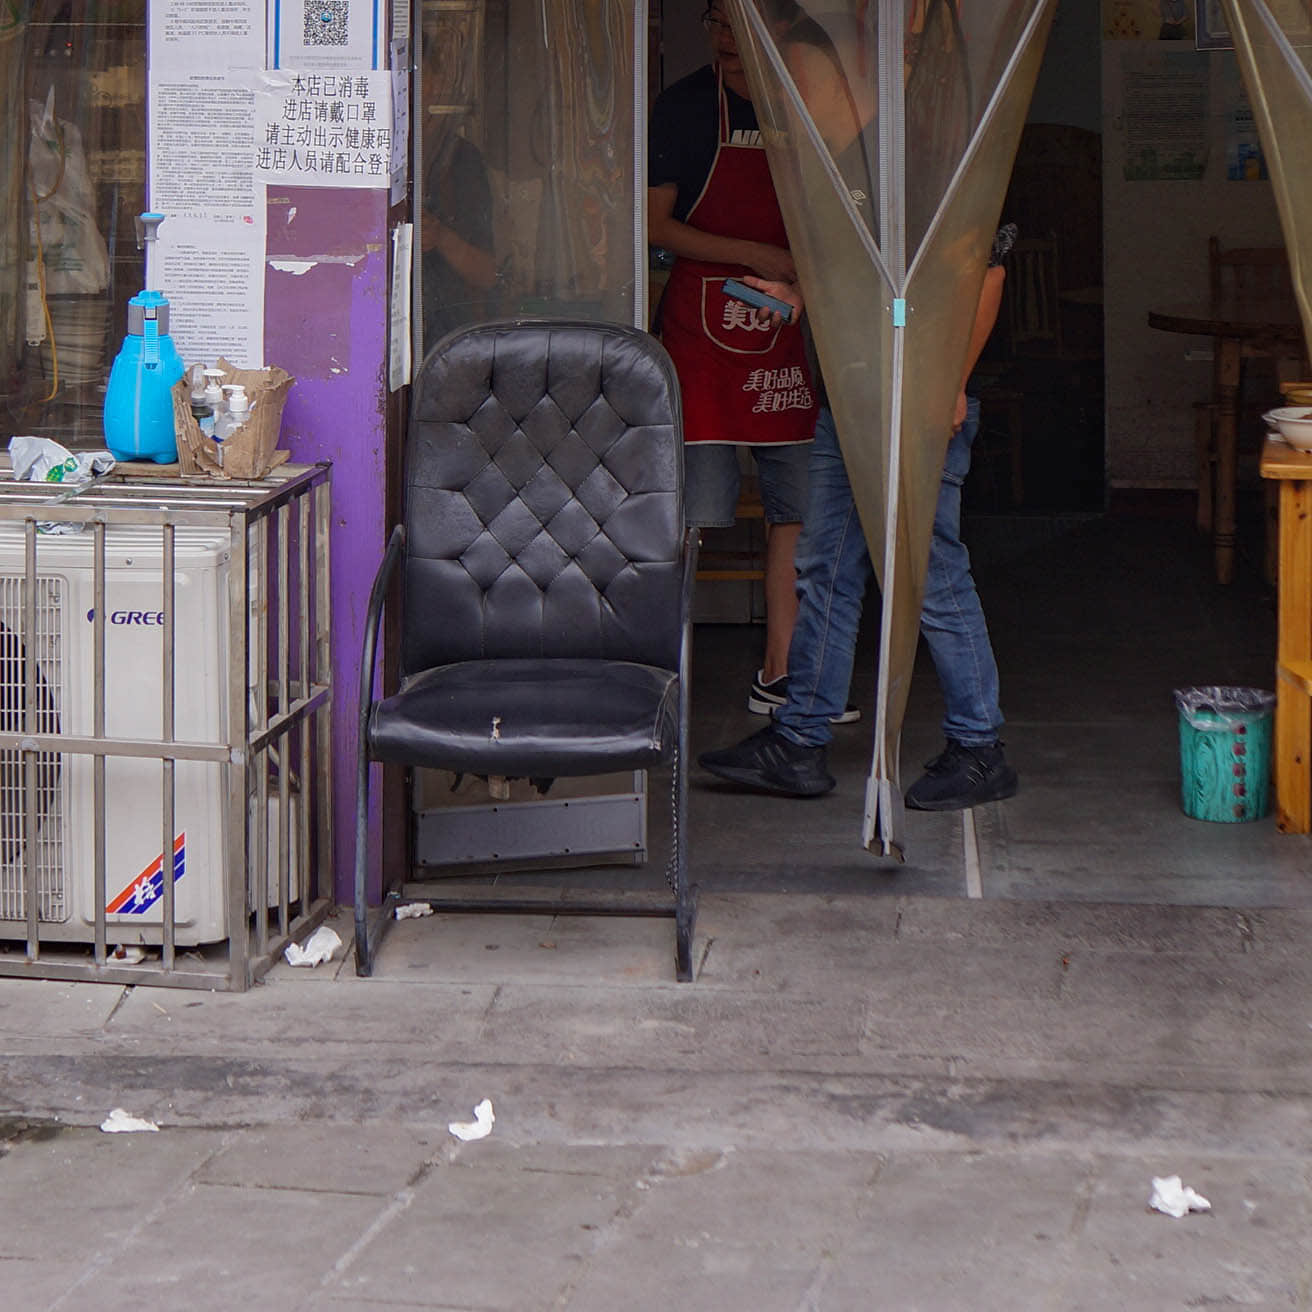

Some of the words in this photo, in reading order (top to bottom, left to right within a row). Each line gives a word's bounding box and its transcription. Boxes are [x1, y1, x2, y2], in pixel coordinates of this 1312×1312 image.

[292, 74, 369, 99] 本店已消毒
[282, 99, 376, 124] 进店请戴口罩
[266, 122, 390, 149] 请主动出示健康码
[742, 366, 806, 392] 美好品质
[752, 387, 813, 413] 美好生活
